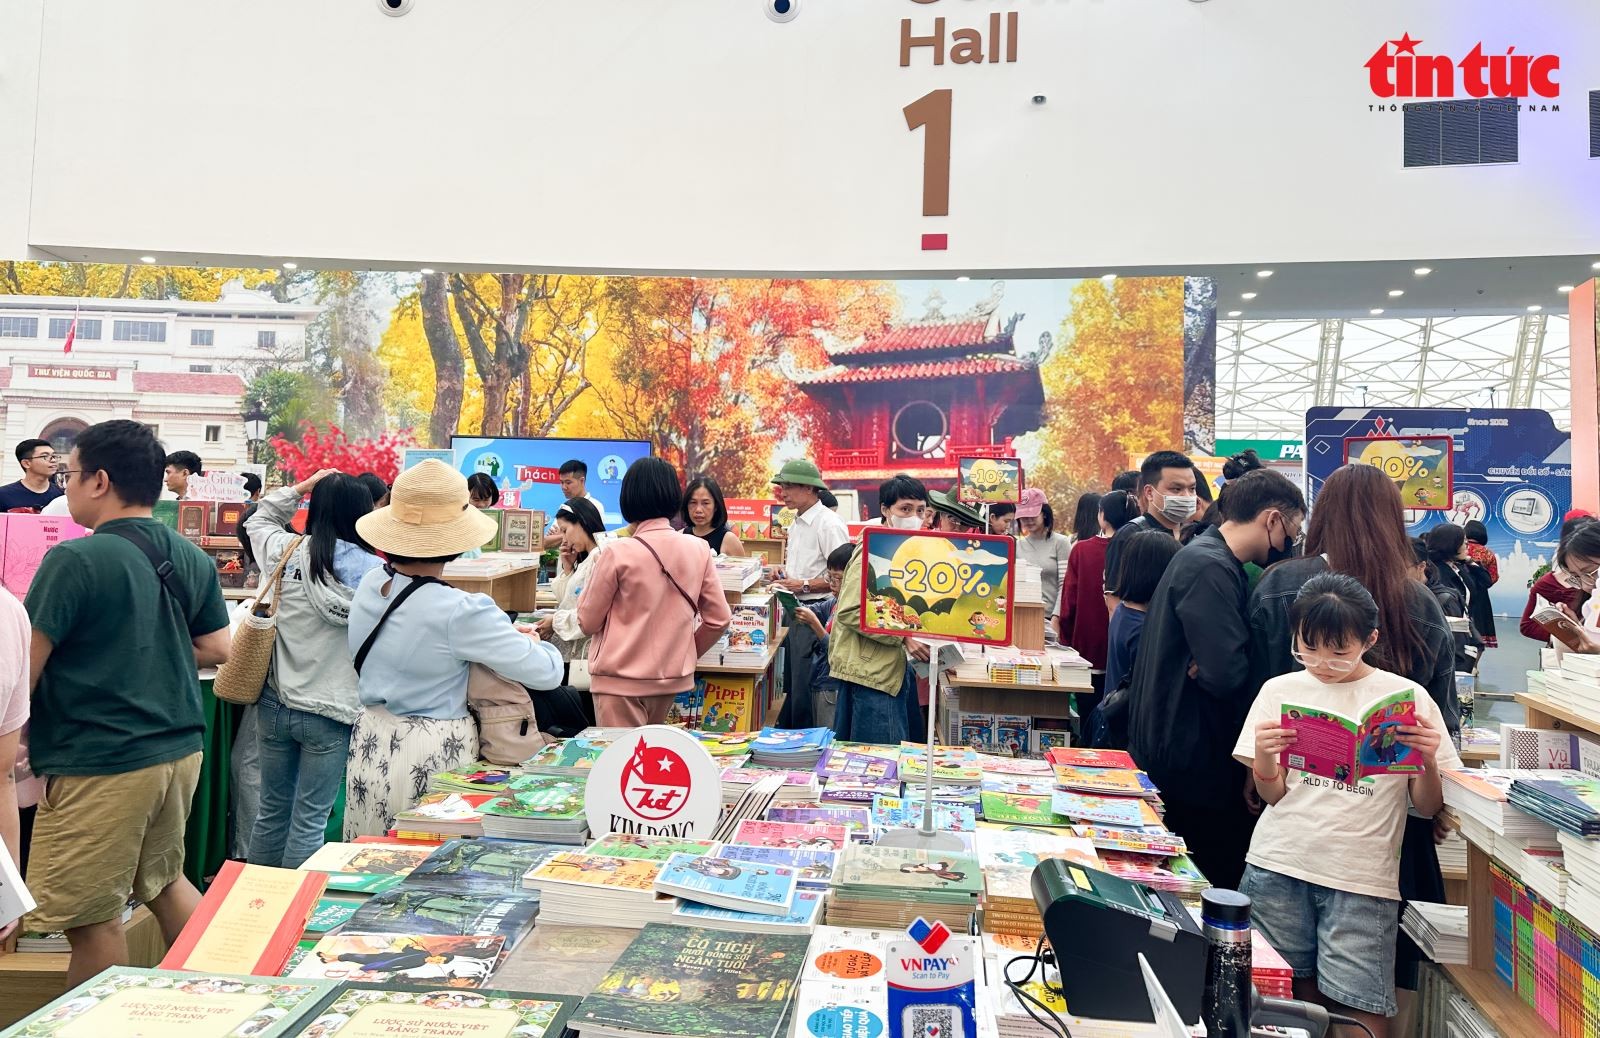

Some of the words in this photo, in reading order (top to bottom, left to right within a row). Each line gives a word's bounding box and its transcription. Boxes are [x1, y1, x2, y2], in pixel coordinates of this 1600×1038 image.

[899, 12, 1018, 66] Hall
[903, 90, 952, 216] 1
[513, 465, 556, 481] Thách
[969, 468, 1011, 484] -10%
[888, 559, 992, 598] -20%
[1322, 779, 1330, 788] IS
[1332, 780, 1344, 791] TO
[1346, 785, 1374, 796] BEGIN
[610, 814, 643, 835] KIM
[714, 940, 755, 955] TÍCH
[676, 953, 714, 967] NGÀN
[900, 958, 948, 972] VNPAY
[912, 972, 928, 980] Scan
[938, 972, 950, 981] Pay
[423, 1028, 465, 1036] TRANH
